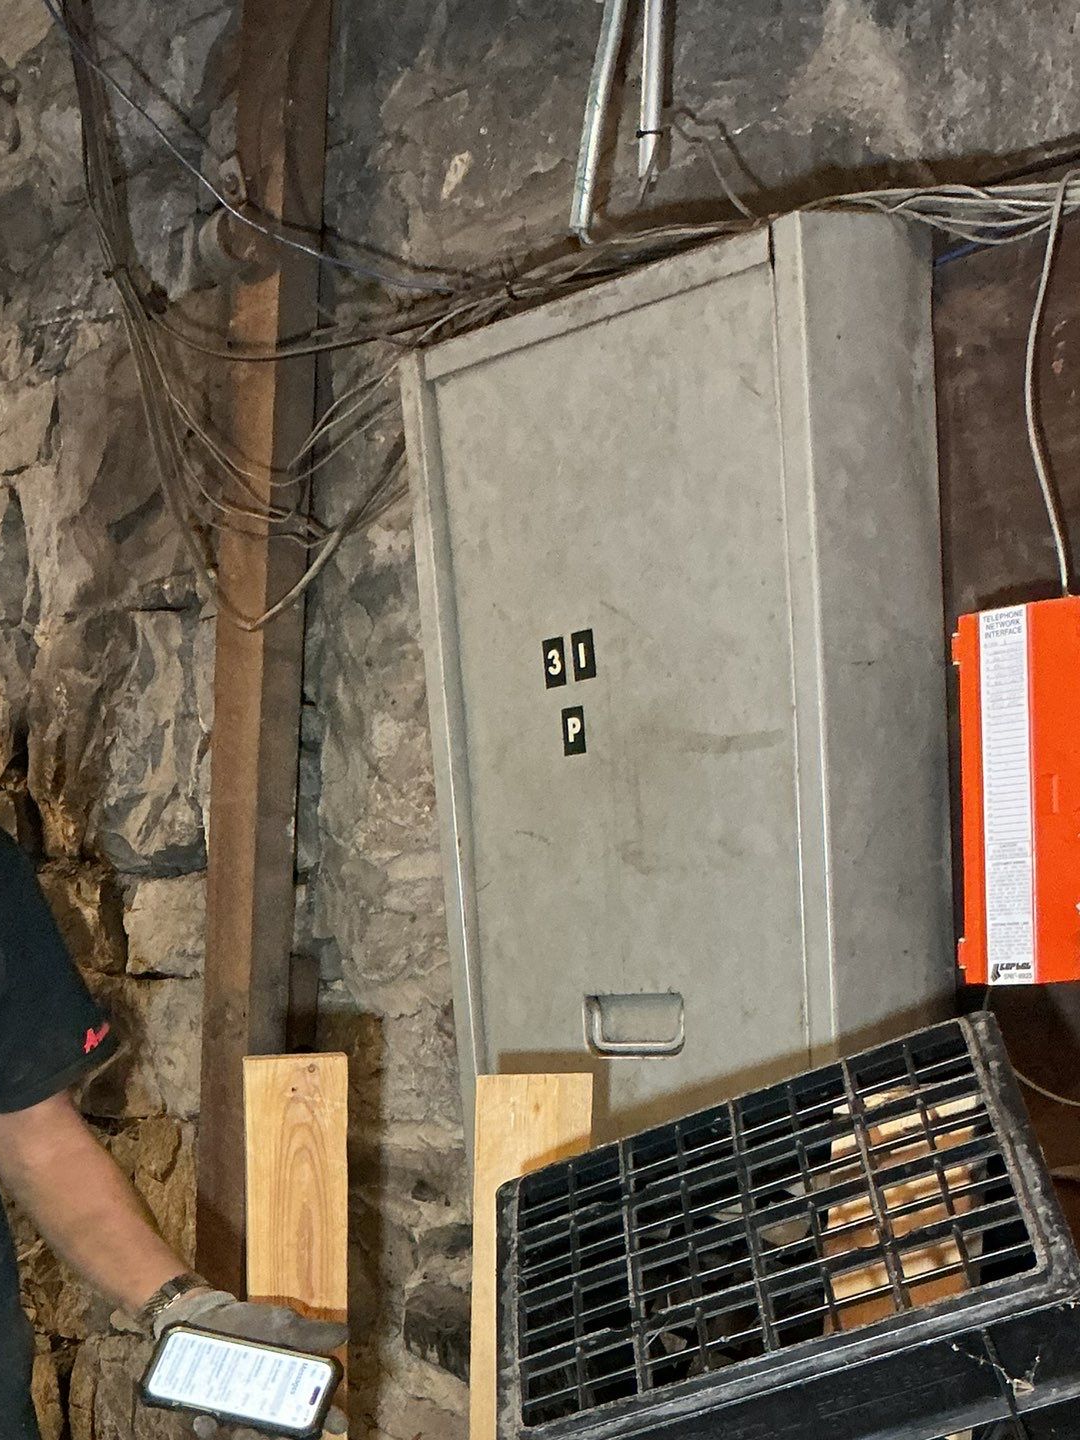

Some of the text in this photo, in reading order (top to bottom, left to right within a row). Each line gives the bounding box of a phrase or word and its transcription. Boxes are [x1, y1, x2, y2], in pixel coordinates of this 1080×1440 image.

[982, 609, 1023, 623] TELEPHONE
[984, 626, 1022, 639] INTERFACE
[566, 716, 582, 743] P
